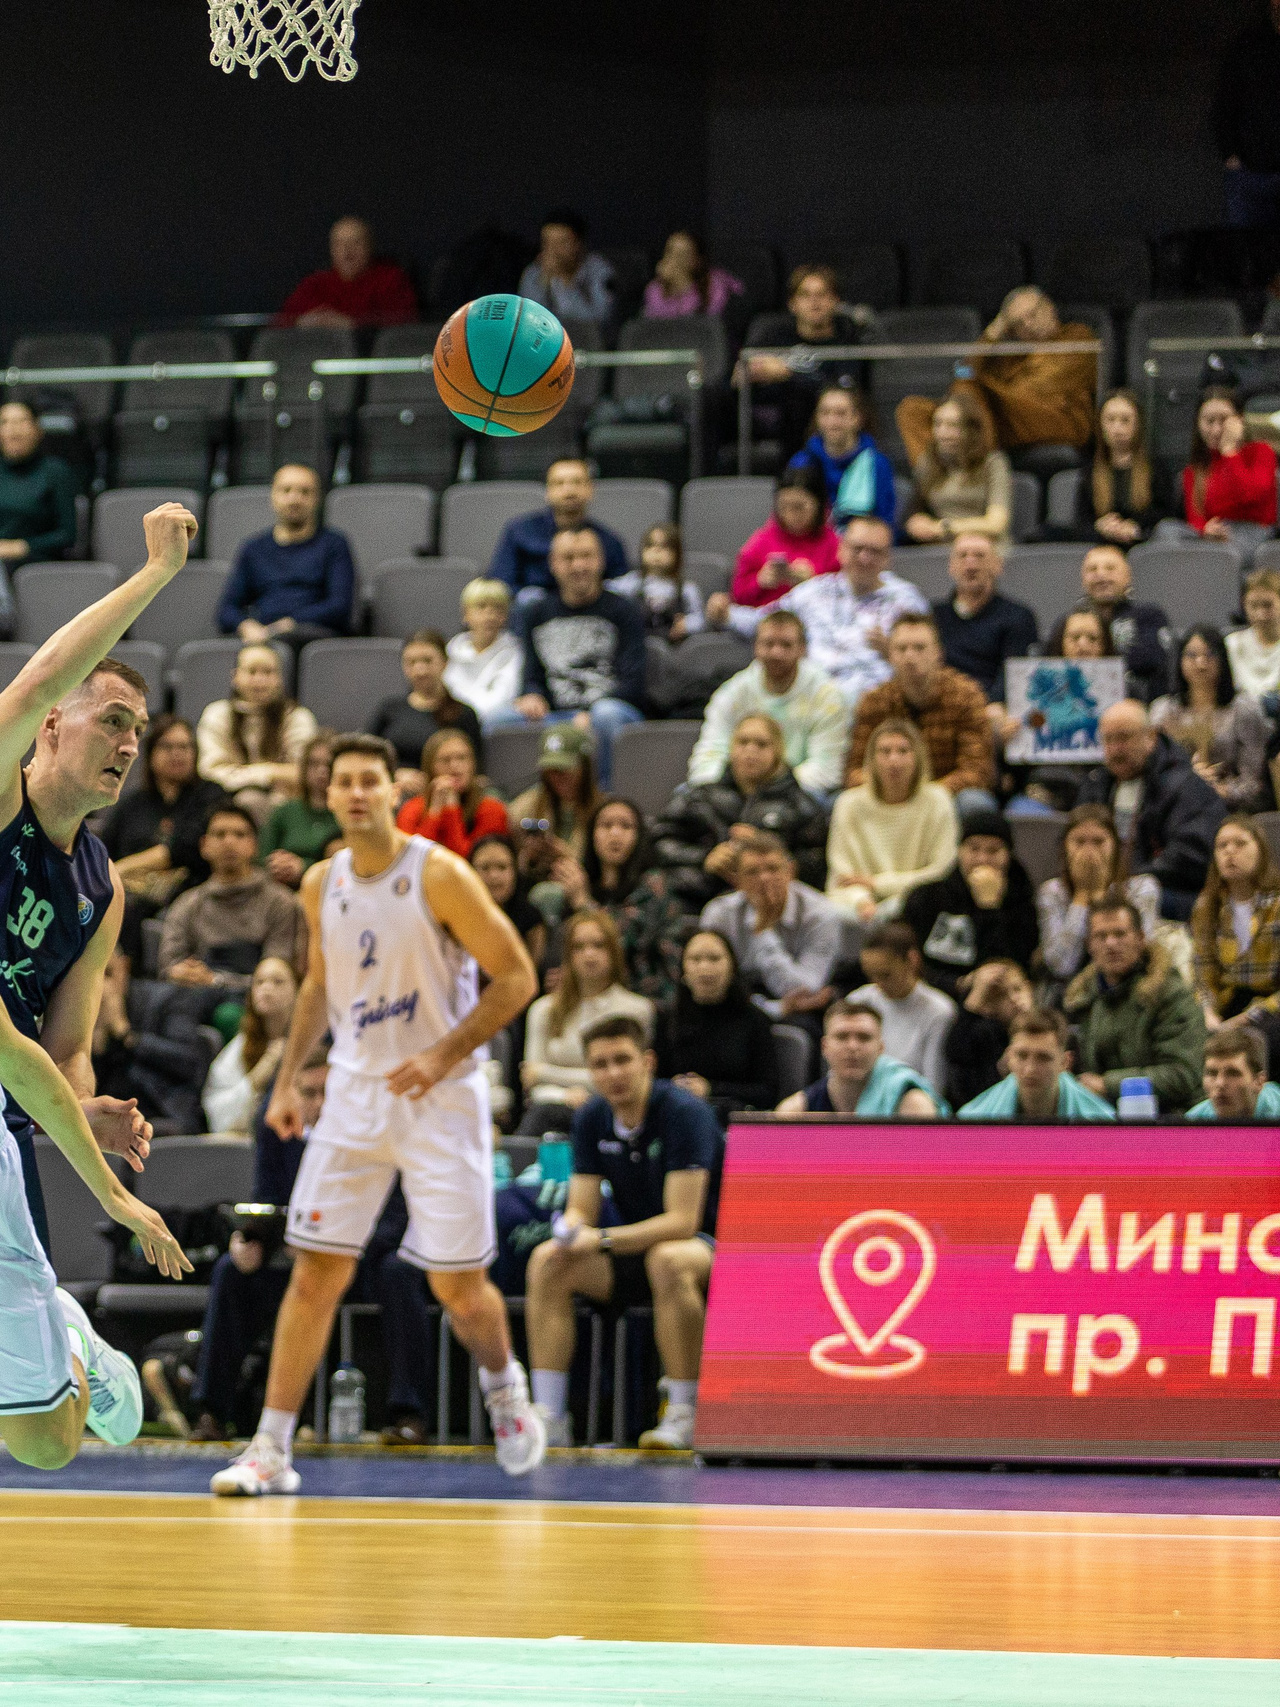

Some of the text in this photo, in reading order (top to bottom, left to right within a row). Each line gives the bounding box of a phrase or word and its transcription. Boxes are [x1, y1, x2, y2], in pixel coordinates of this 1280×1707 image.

[6, 886, 55, 949] 38
[358, 930, 377, 968] 2
[1006, 1313, 1167, 1396] пр.
